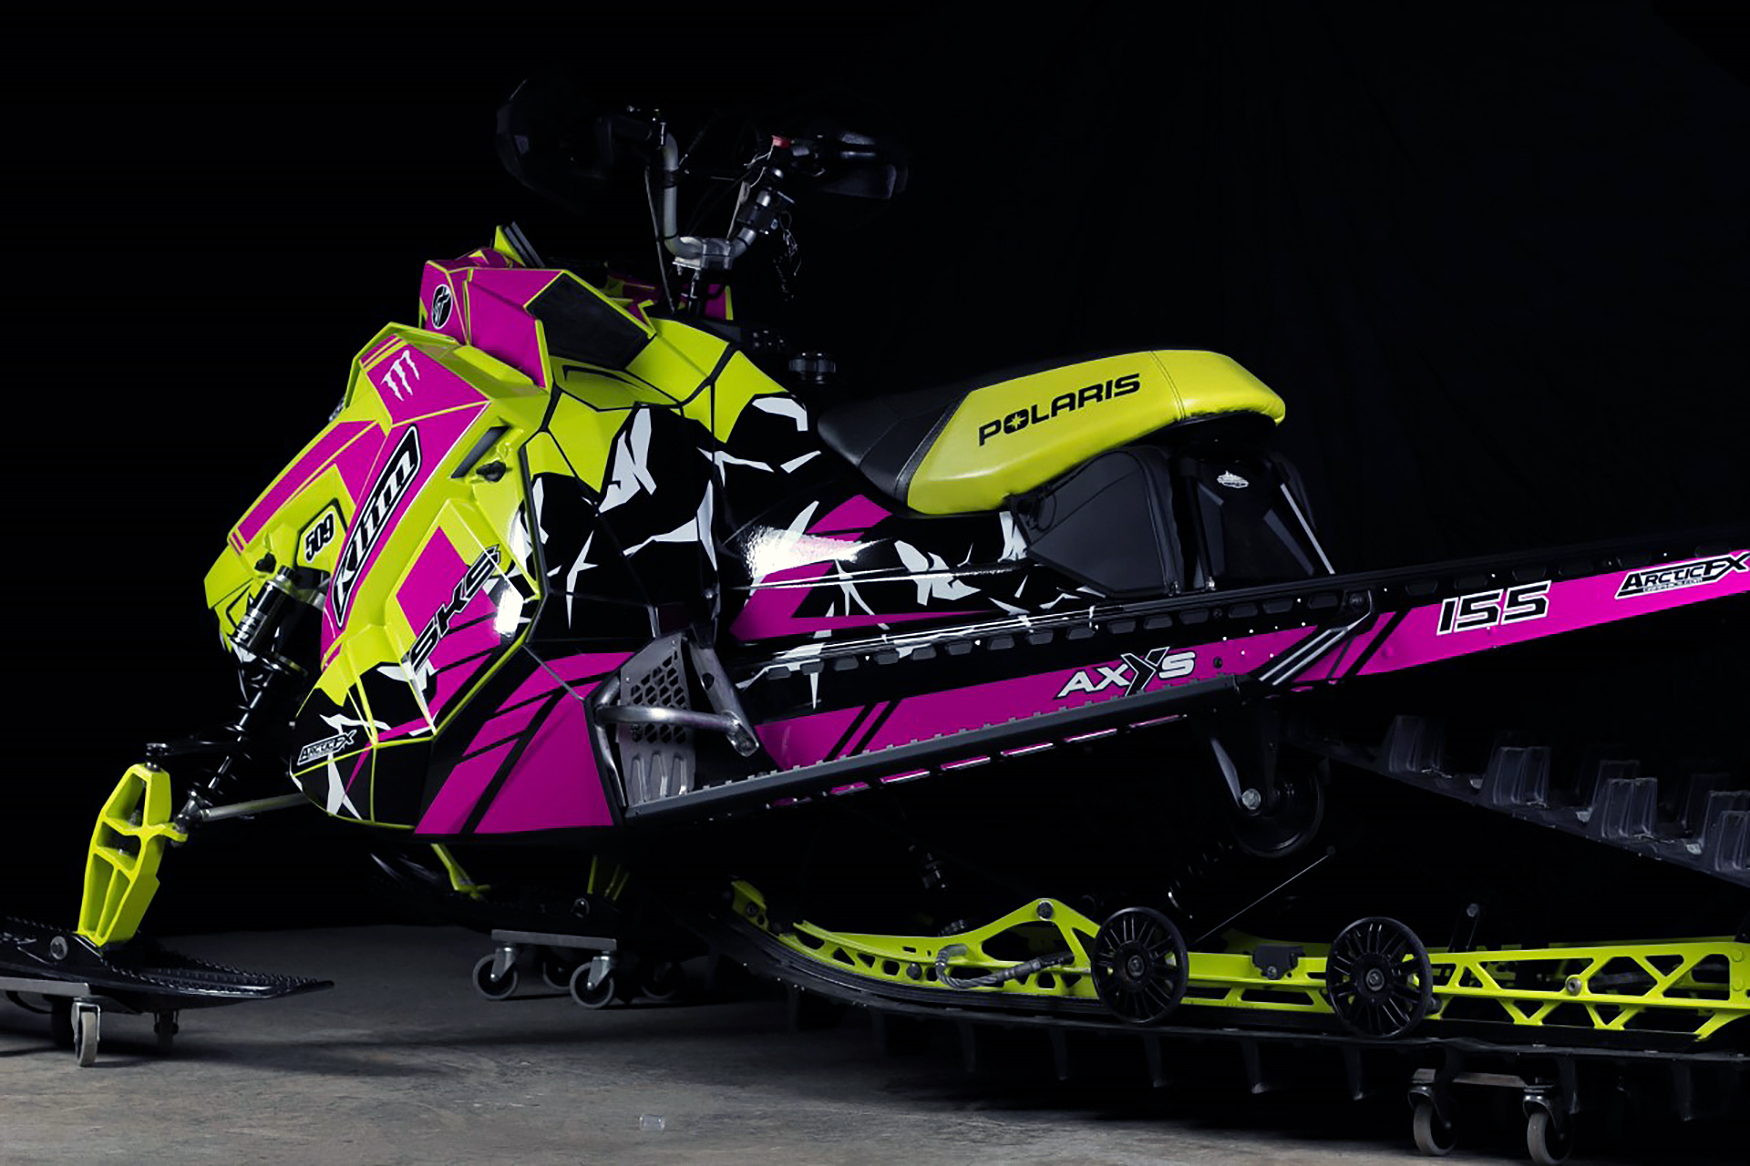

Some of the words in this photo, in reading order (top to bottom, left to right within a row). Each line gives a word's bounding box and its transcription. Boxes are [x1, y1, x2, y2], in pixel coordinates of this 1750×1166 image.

[978, 373, 1141, 447] POLARIS
[303, 511, 335, 563] 509
[409, 543, 500, 675] SKS
[1436, 580, 1552, 636] 155
[1053, 646, 1197, 699] AXYS
